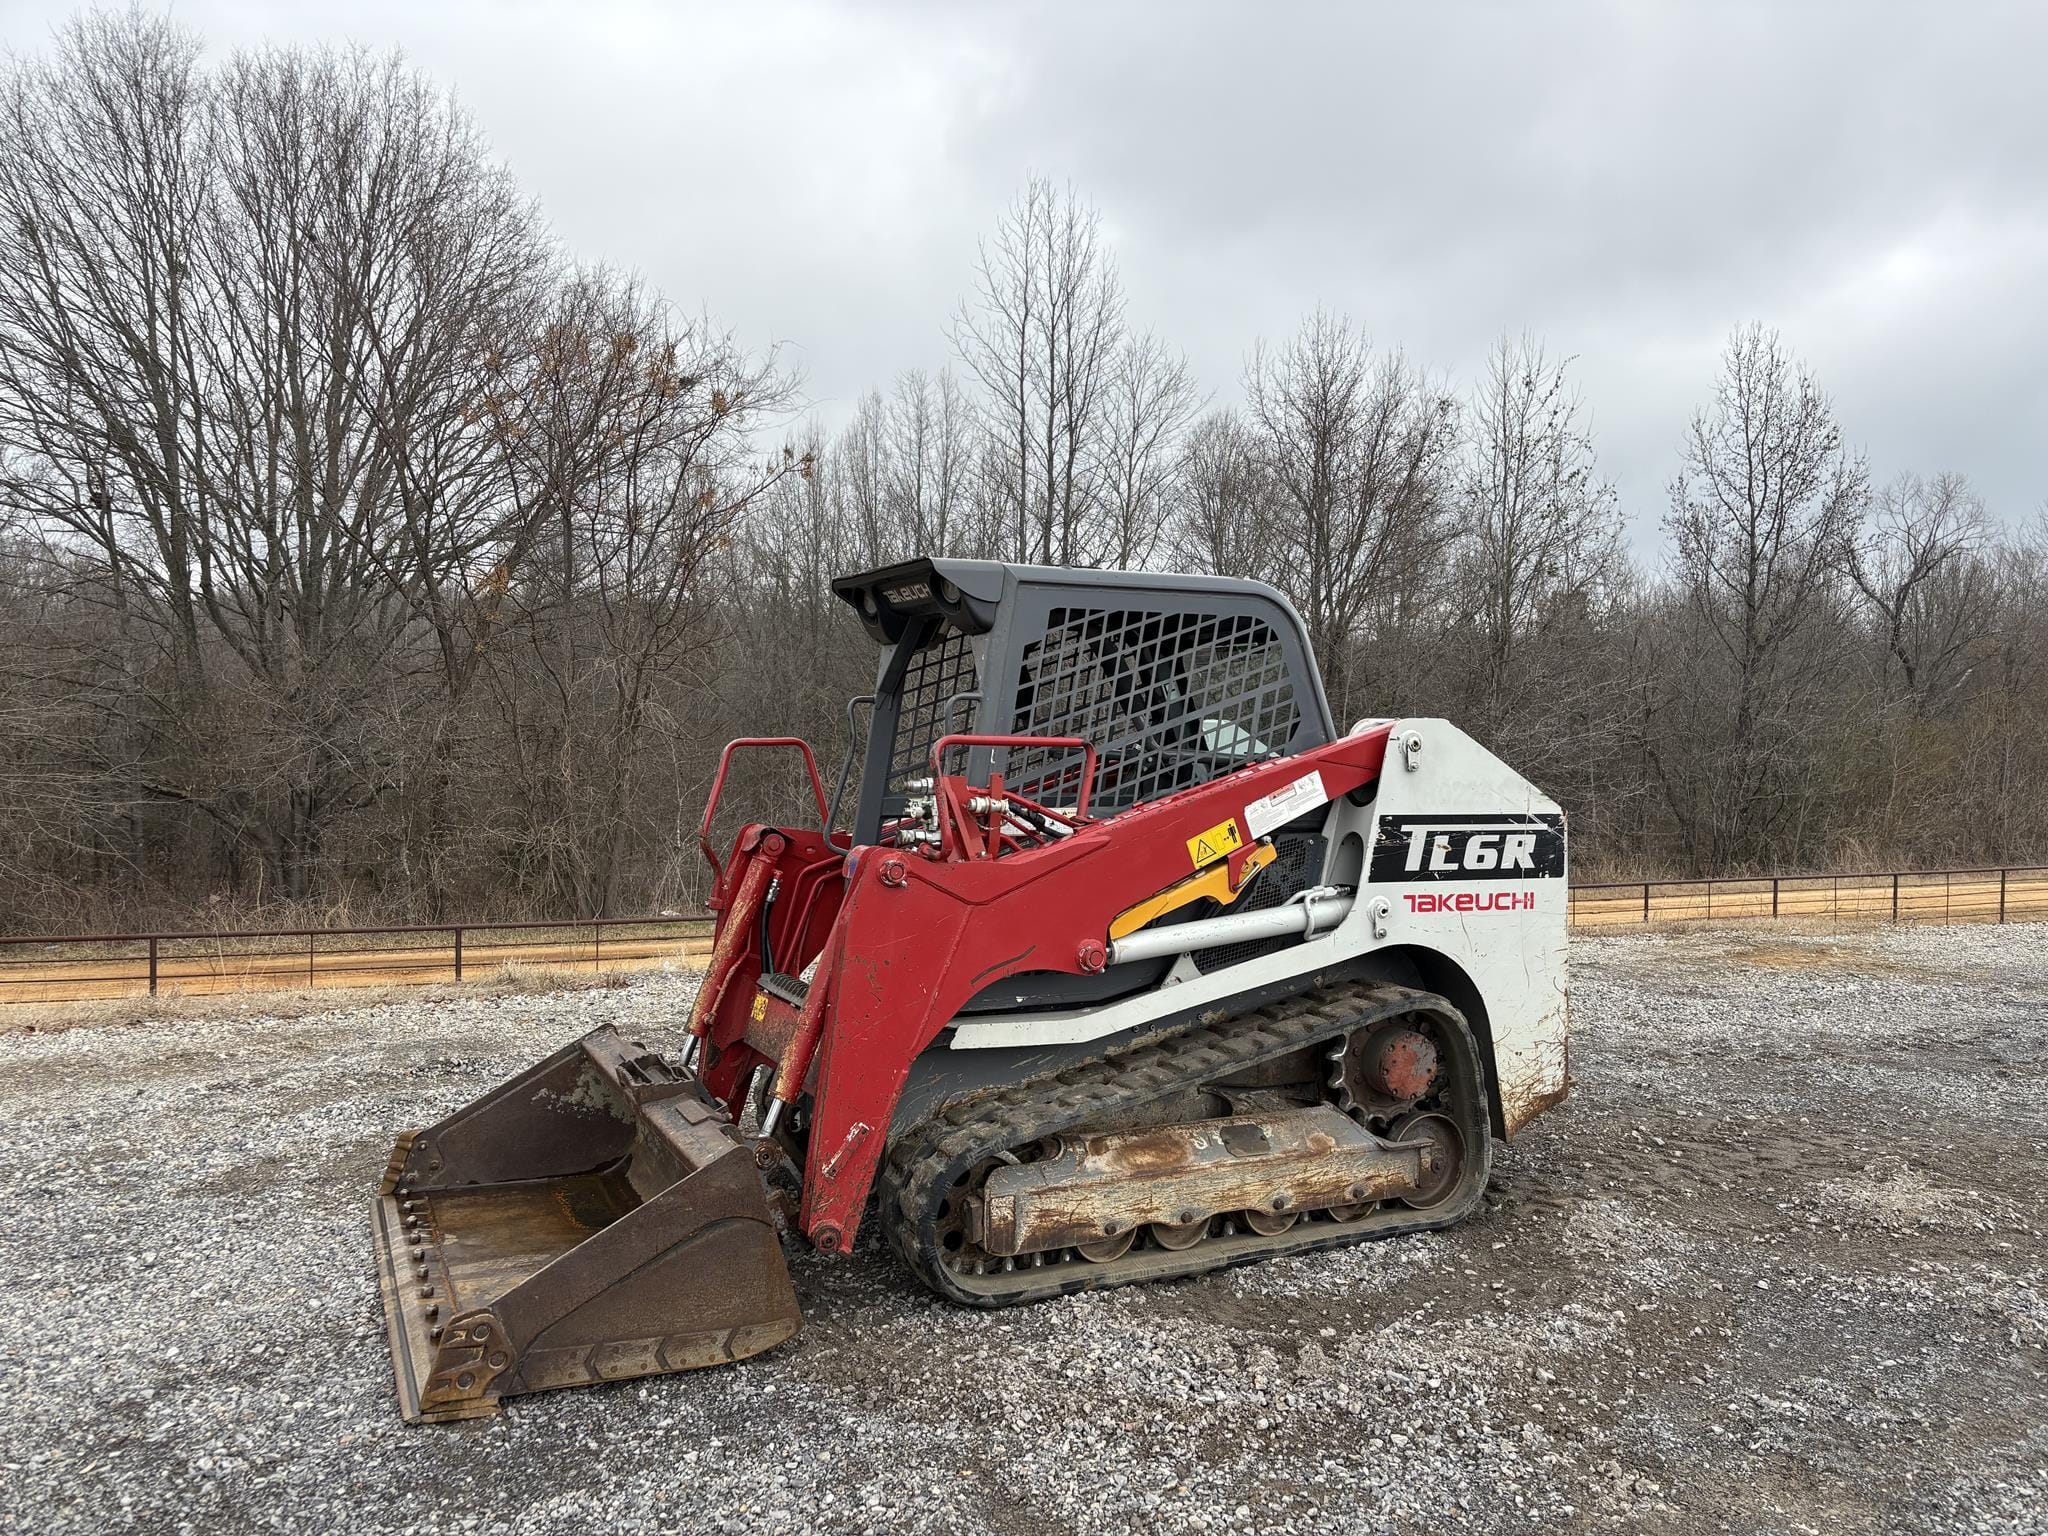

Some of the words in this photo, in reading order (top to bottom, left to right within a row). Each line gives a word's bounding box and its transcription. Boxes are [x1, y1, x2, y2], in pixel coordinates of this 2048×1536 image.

[882, 583, 932, 603] TAKEUCH
[1401, 823, 1548, 872] TL6R
[1403, 892, 1535, 913] TAKEUCHI
